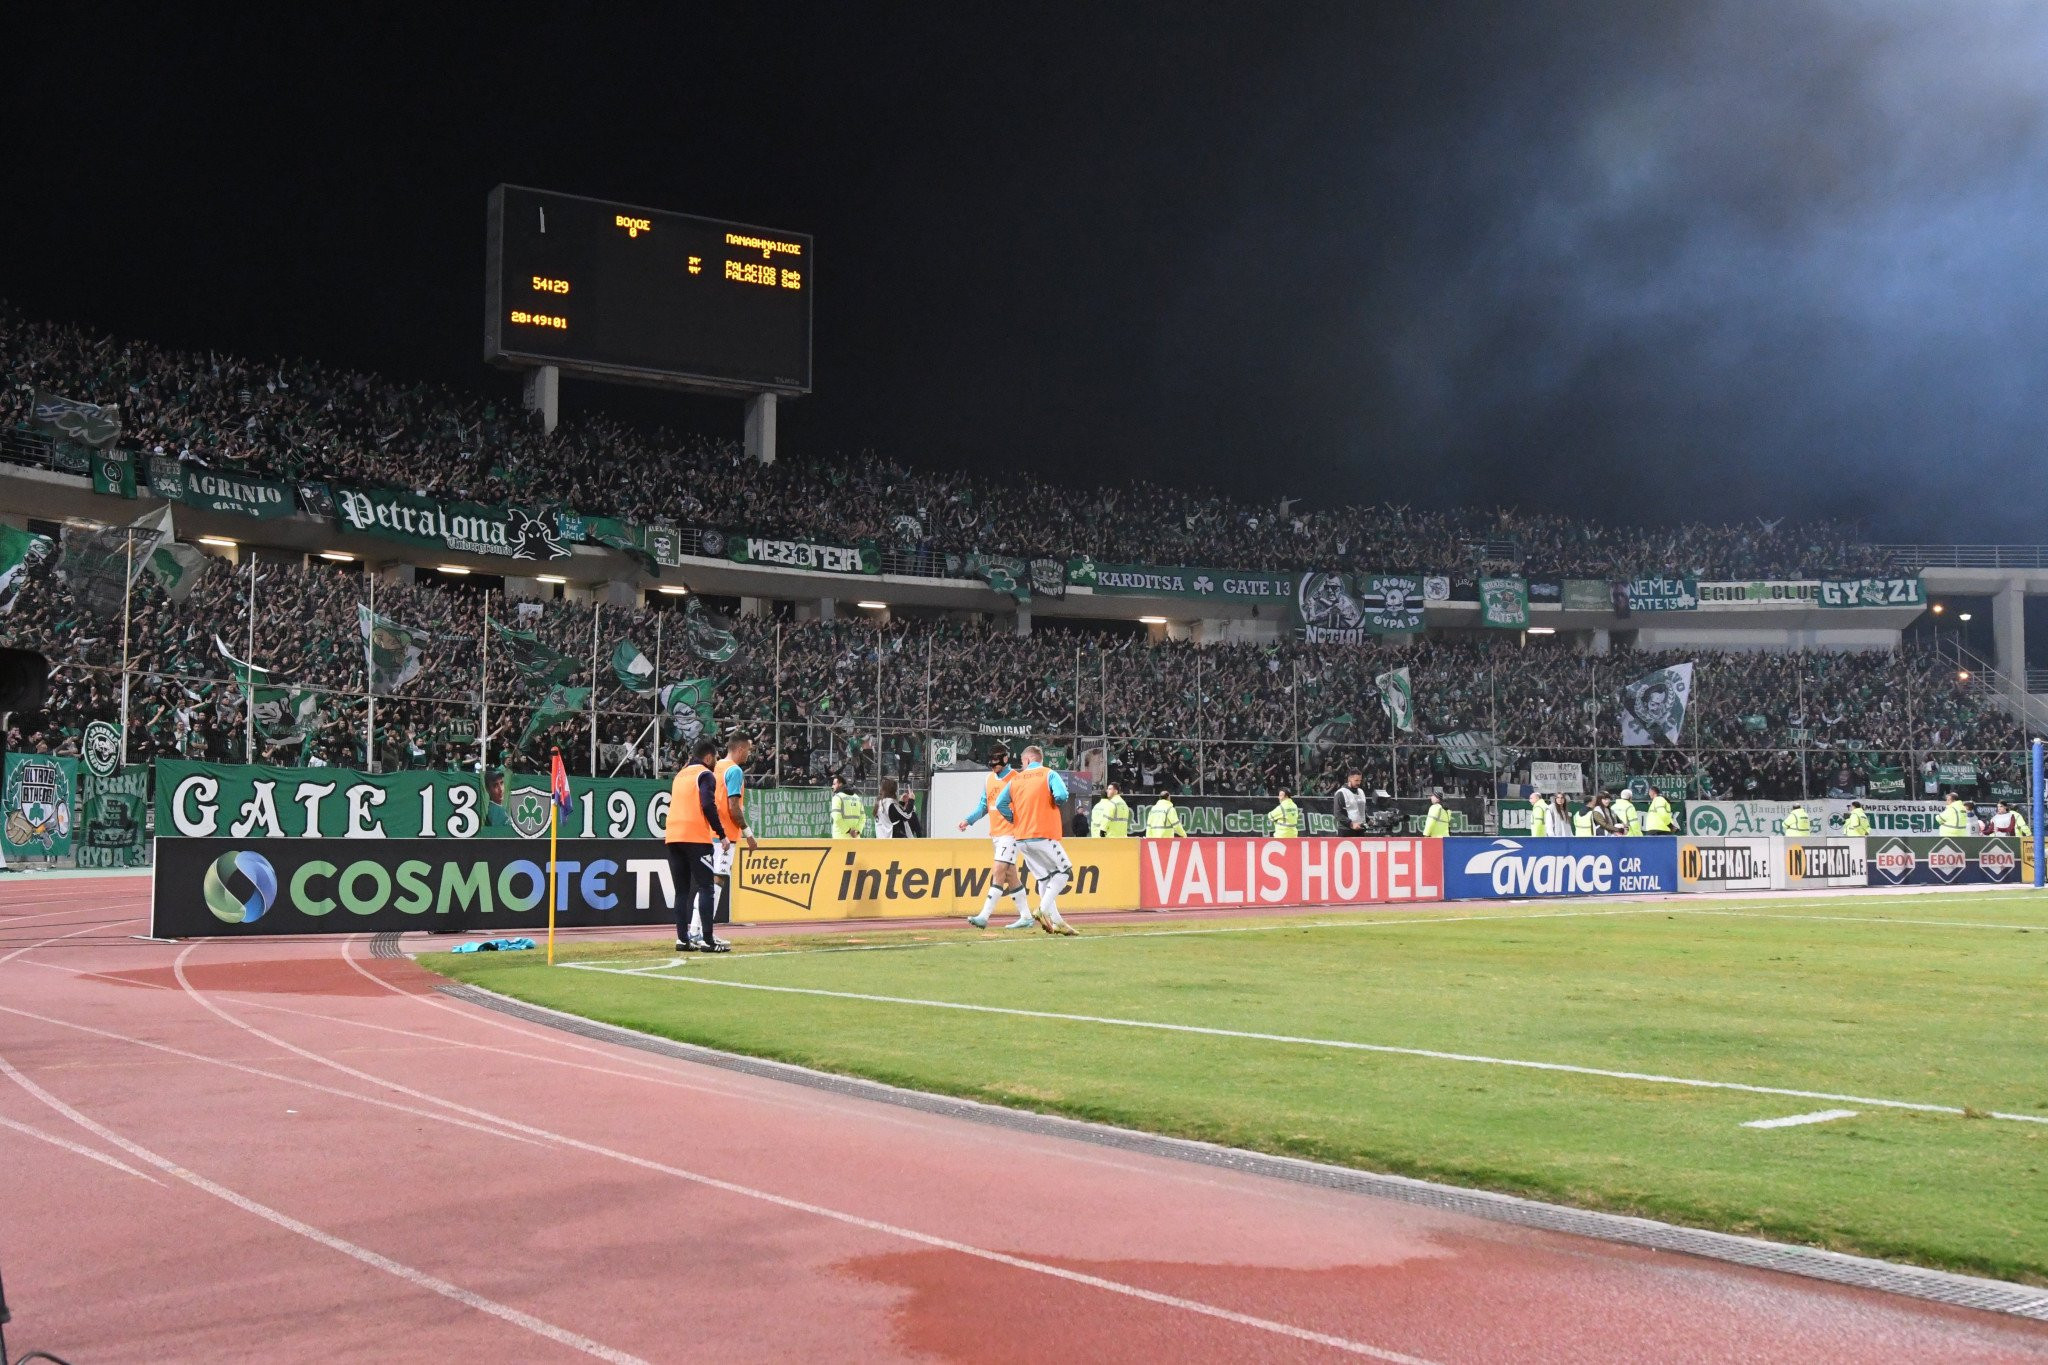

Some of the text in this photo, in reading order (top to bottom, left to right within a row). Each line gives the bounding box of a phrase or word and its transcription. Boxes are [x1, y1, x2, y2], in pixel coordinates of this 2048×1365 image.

[726, 233, 801, 255] ΠΑΝΑΘΗΝΑΙΚΟΣ
[763, 249, 771, 259] 2
[726, 260, 776, 277] PALACIOS
[782, 269, 801, 281] Seb
[532, 276, 569, 293] 54:29
[726, 270, 776, 286] PALACIOS
[782, 278, 801, 290] Seb
[511, 311, 567, 329] 20:49:01
[188, 472, 282, 504] AGRINIO
[213, 501, 243, 511] GATE
[339, 490, 507, 545] Petralona
[560, 513, 583, 524] FEEL
[560, 530, 585, 541] MAGIC
[447, 537, 513, 556] Underground
[1098, 571, 1291, 596] KARDITSA GATE 13
[1629, 579, 1684, 596] NEMEA
[1373, 616, 1420, 629] ΘΥΡΑ 13
[979, 723, 1032, 739] HOOLIGANS
[1652, 777, 1687, 789] SERIFOS
[807, 790, 833, 802] ΧΤΙΖΟ
[1678, 790, 1687, 799] 13
[170, 773, 672, 839] GATE 13 196
[1893, 804, 1926, 812] STRIKES
[1131, 803, 1224, 835] JDAN
[1728, 803, 1822, 835] Args
[1847, 812, 1942, 830] ATISSI
[1001, 846, 1007, 857] 7
[745, 854, 788, 871] inter
[1619, 857, 1641, 873] CAR
[751, 868, 811, 885] wetten
[838, 851, 1100, 901] interwtn
[1148, 840, 1438, 905] VALIS HOTEL
[1492, 854, 1613, 895] avance
[290, 858, 618, 917] COSMOTE
[1619, 875, 1661, 891] RENTAL
